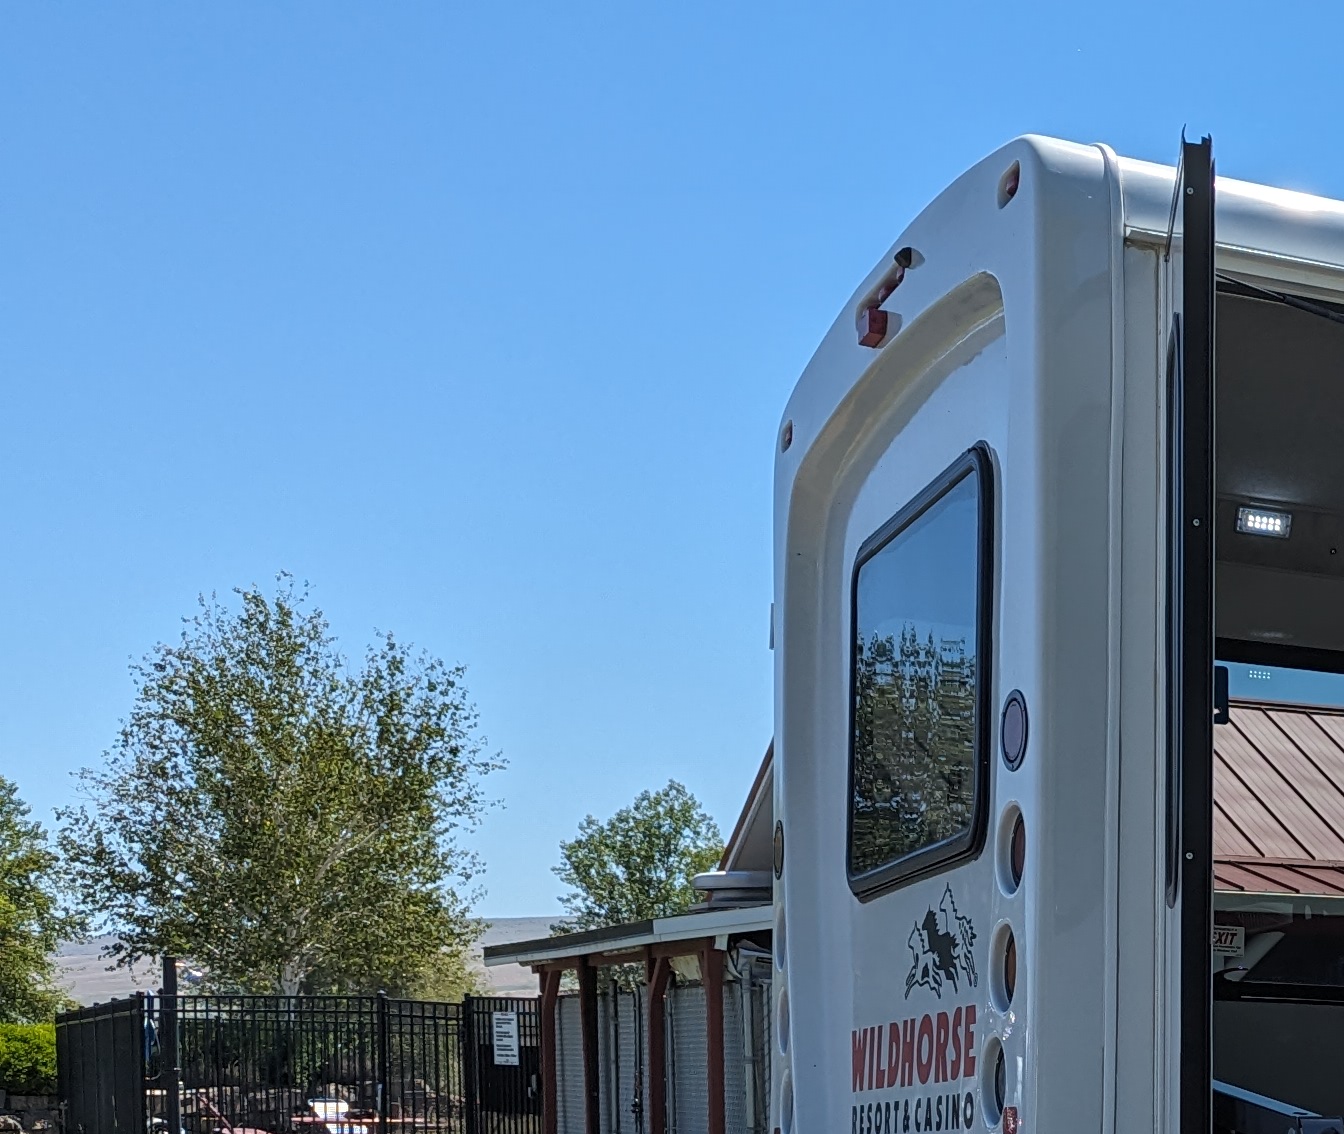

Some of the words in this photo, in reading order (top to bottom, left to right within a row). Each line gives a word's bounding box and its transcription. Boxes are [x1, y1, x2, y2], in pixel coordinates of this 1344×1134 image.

[851, 1004, 976, 1093] WILDHORSE
[902, 1098, 910, 1134] &
[914, 1091, 974, 1133] CASINO
